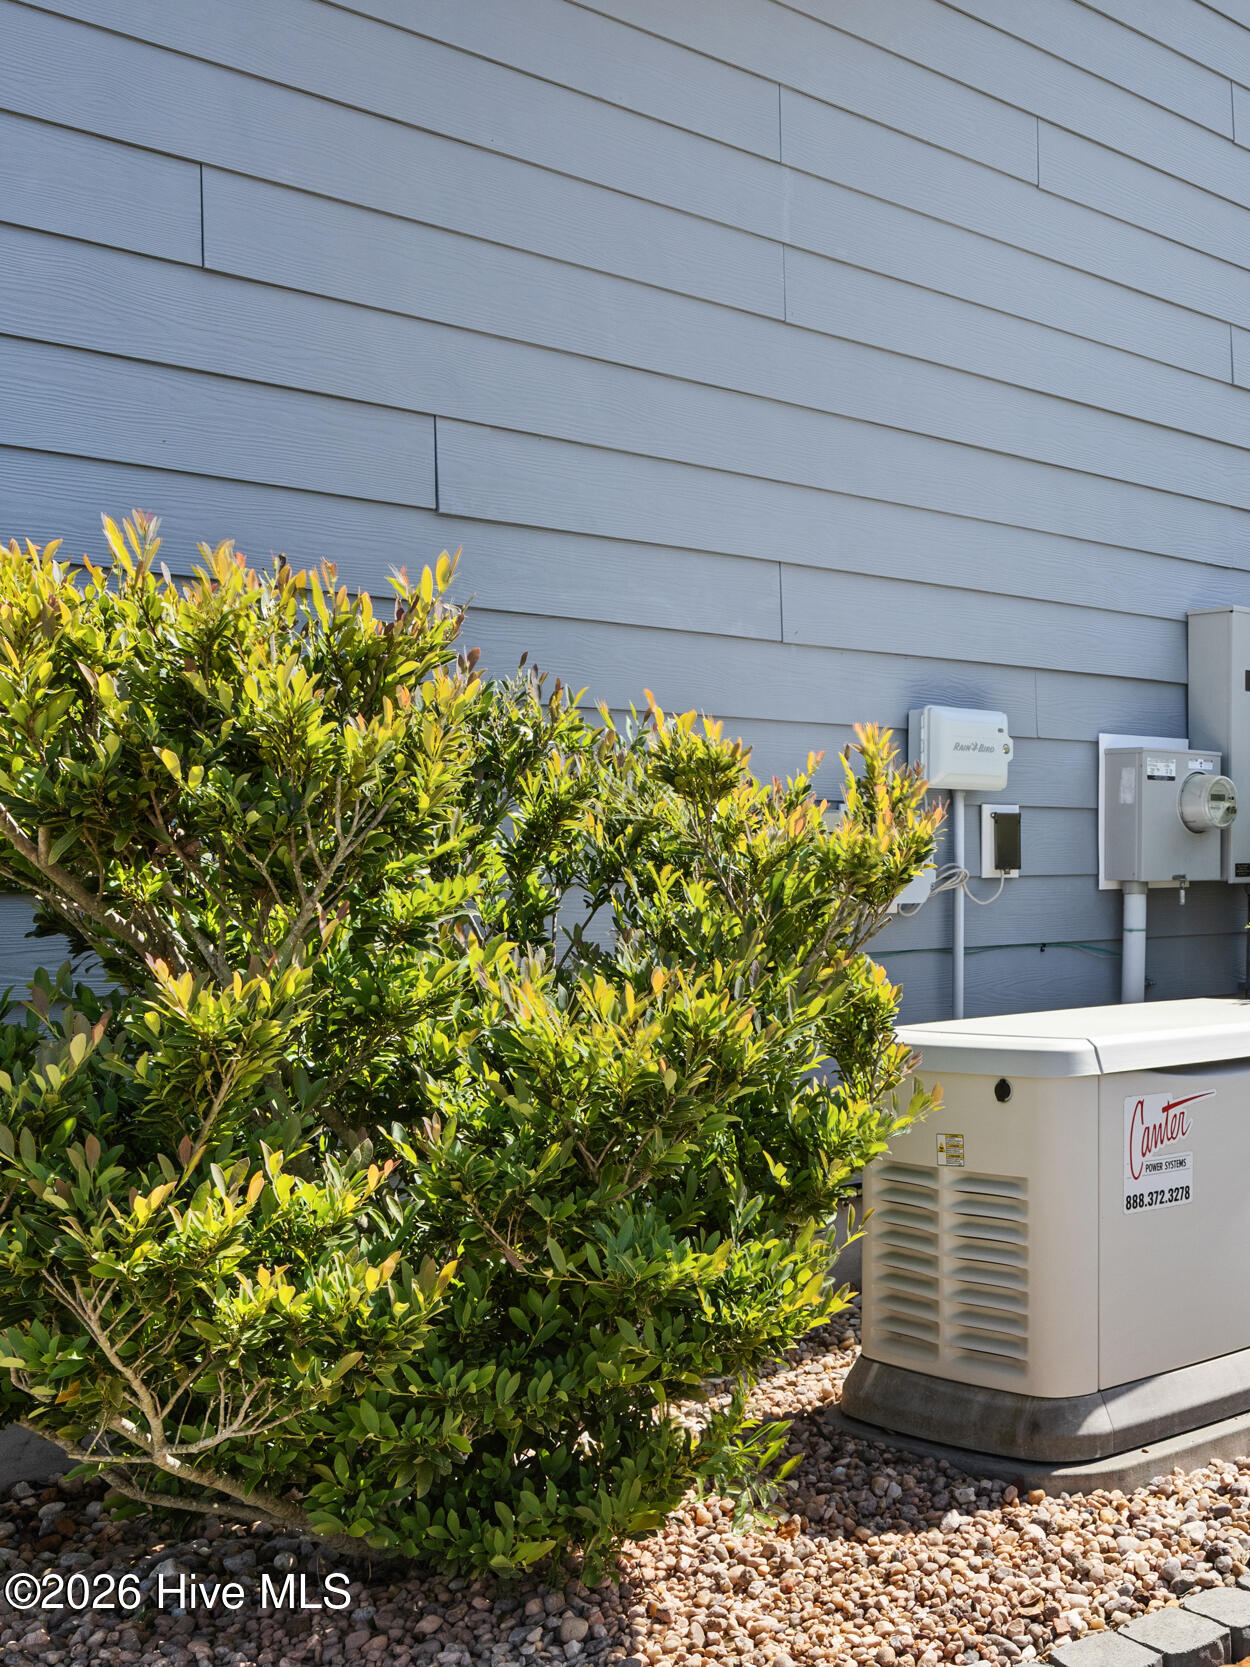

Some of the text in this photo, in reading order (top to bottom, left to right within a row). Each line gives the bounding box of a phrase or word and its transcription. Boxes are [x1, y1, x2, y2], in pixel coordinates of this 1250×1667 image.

[1129, 1091, 1215, 1180] Canter
[1145, 1158, 1187, 1173] POWER SYSTEMS
[1125, 1185, 1190, 1211] 888.372.3278
